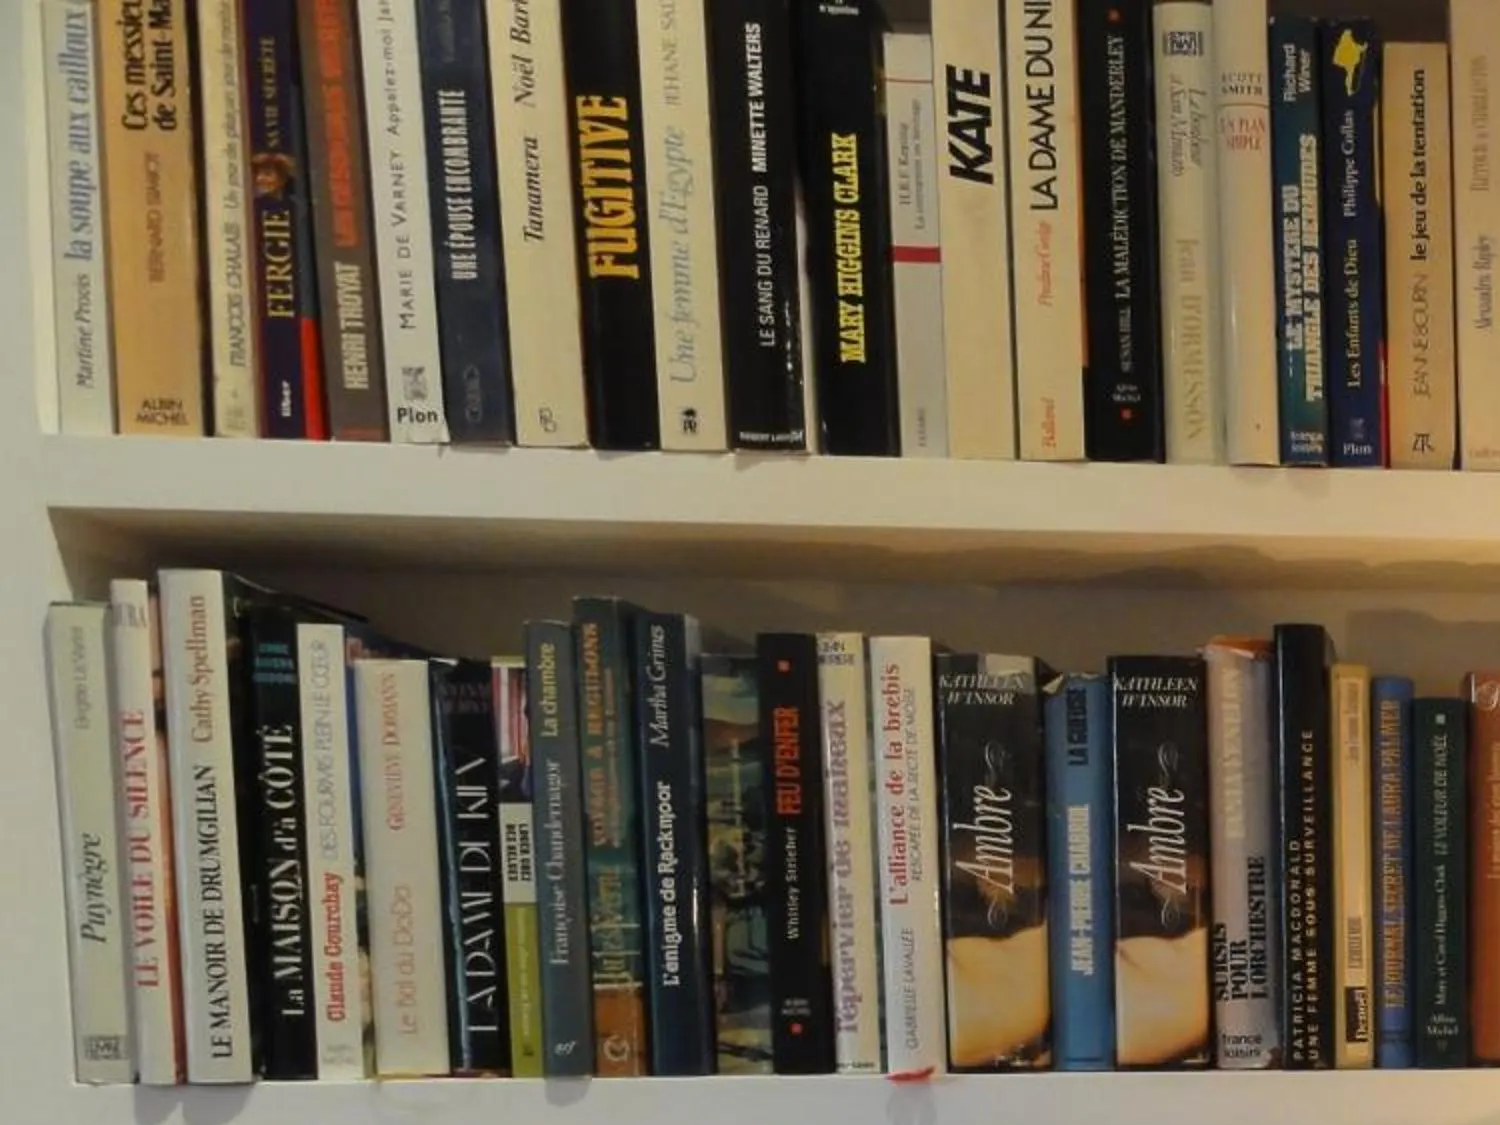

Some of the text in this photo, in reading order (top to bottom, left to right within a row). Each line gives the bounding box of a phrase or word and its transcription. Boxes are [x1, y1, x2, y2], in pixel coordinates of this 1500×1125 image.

[58, 10, 96, 261] la soupe aux cailloux
[121, 93, 147, 130] Ces
[154, 105, 177, 131] de
[945, 63, 994, 185] KATE
[1024, 34, 1054, 77] DU
[1025, 83, 1057, 171] DAME
[1282, 43, 1297, 102] Richard
[1297, 50, 1312, 92] Winer
[438, 90, 477, 280] UNE ÉPOUSE ENCOMBRANTE
[510, 54, 545, 242] Tanamera Noël
[576, 95, 640, 279] FUGITIVE
[745, 23, 775, 346] LE SANG DU RENARD MINETTE WALTERS
[1030, 178, 1058, 211] LA
[1106, 34, 1131, 299] LA MALÉDICTION DE MANDERLEY
[1409, 69, 1429, 261] le jeu de la tentation
[263, 210, 295, 318] FERGIE
[334, 261, 367, 328] TROYAT
[389, 149, 416, 329] MARIE DE VARNEY
[667, 240, 700, 383] Une femme
[832, 132, 866, 363] MARY HIGGINS CLARK
[1342, 158, 1363, 387] Les Enfants de Dieu Philippe
[74, 327, 94, 388] Martine
[340, 334, 369, 389] HENRI
[396, 407, 439, 424] Plon
[120, 710, 161, 987] LE VOILE DU SILENCE
[186, 594, 234, 1059] LE MANOIR DE Cathy Spellman
[537, 642, 570, 965] Françoise Chandernagor La chambre
[647, 624, 682, 986] L'énigme de Rackmoor Martha Grimes
[773, 707, 801, 940] Whitley FEU D'ENFER
[880, 663, 911, 906] L'alliance de la brebis
[952, 784, 1014, 894] Ambre
[1127, 786, 1188, 894] Ambre
[76, 833, 109, 943] Puynègre
[256, 724, 306, 1016] La MAISON CÔTÉ
[322, 872, 346, 1022] Claude Courchay
[1289, 840, 1304, 1060] PATRICIA MACDONALD
[1301, 729, 1319, 1060] UNE FEMME SOUS SURVEILLANCE
[1229, 939, 1249, 1000] POUR
